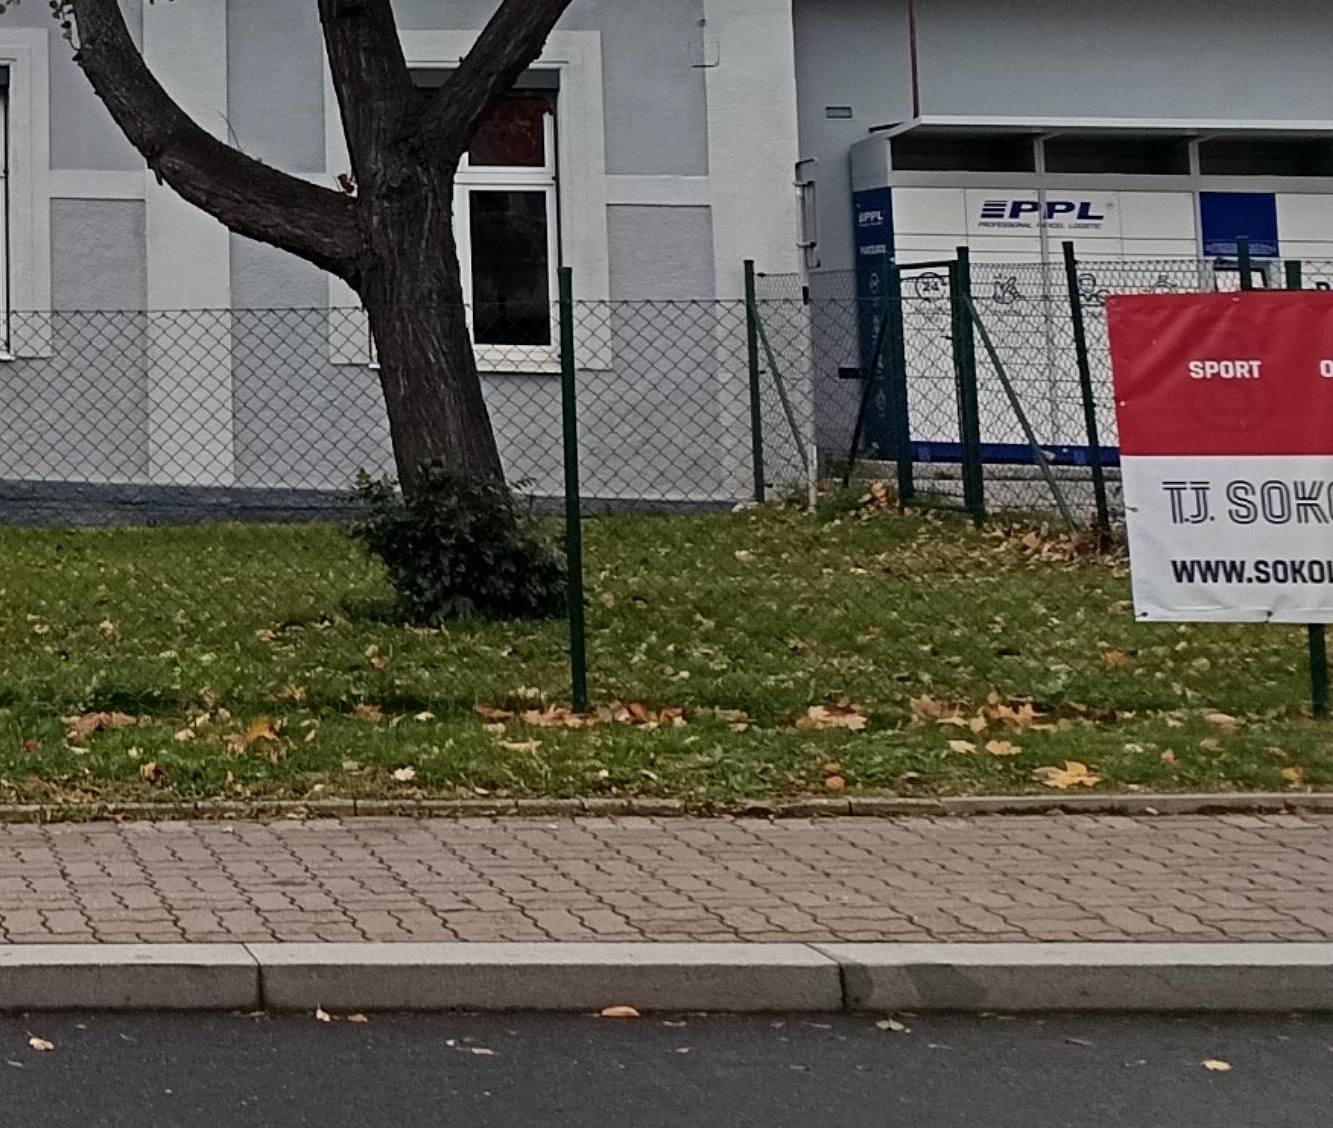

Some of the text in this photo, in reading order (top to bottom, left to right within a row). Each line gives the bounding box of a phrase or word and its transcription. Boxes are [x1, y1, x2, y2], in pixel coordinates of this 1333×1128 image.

[1009, 201, 1104, 220] PPL
[1189, 360, 1261, 379] SPORT
[1162, 479, 1333, 525] T.J. SOK
